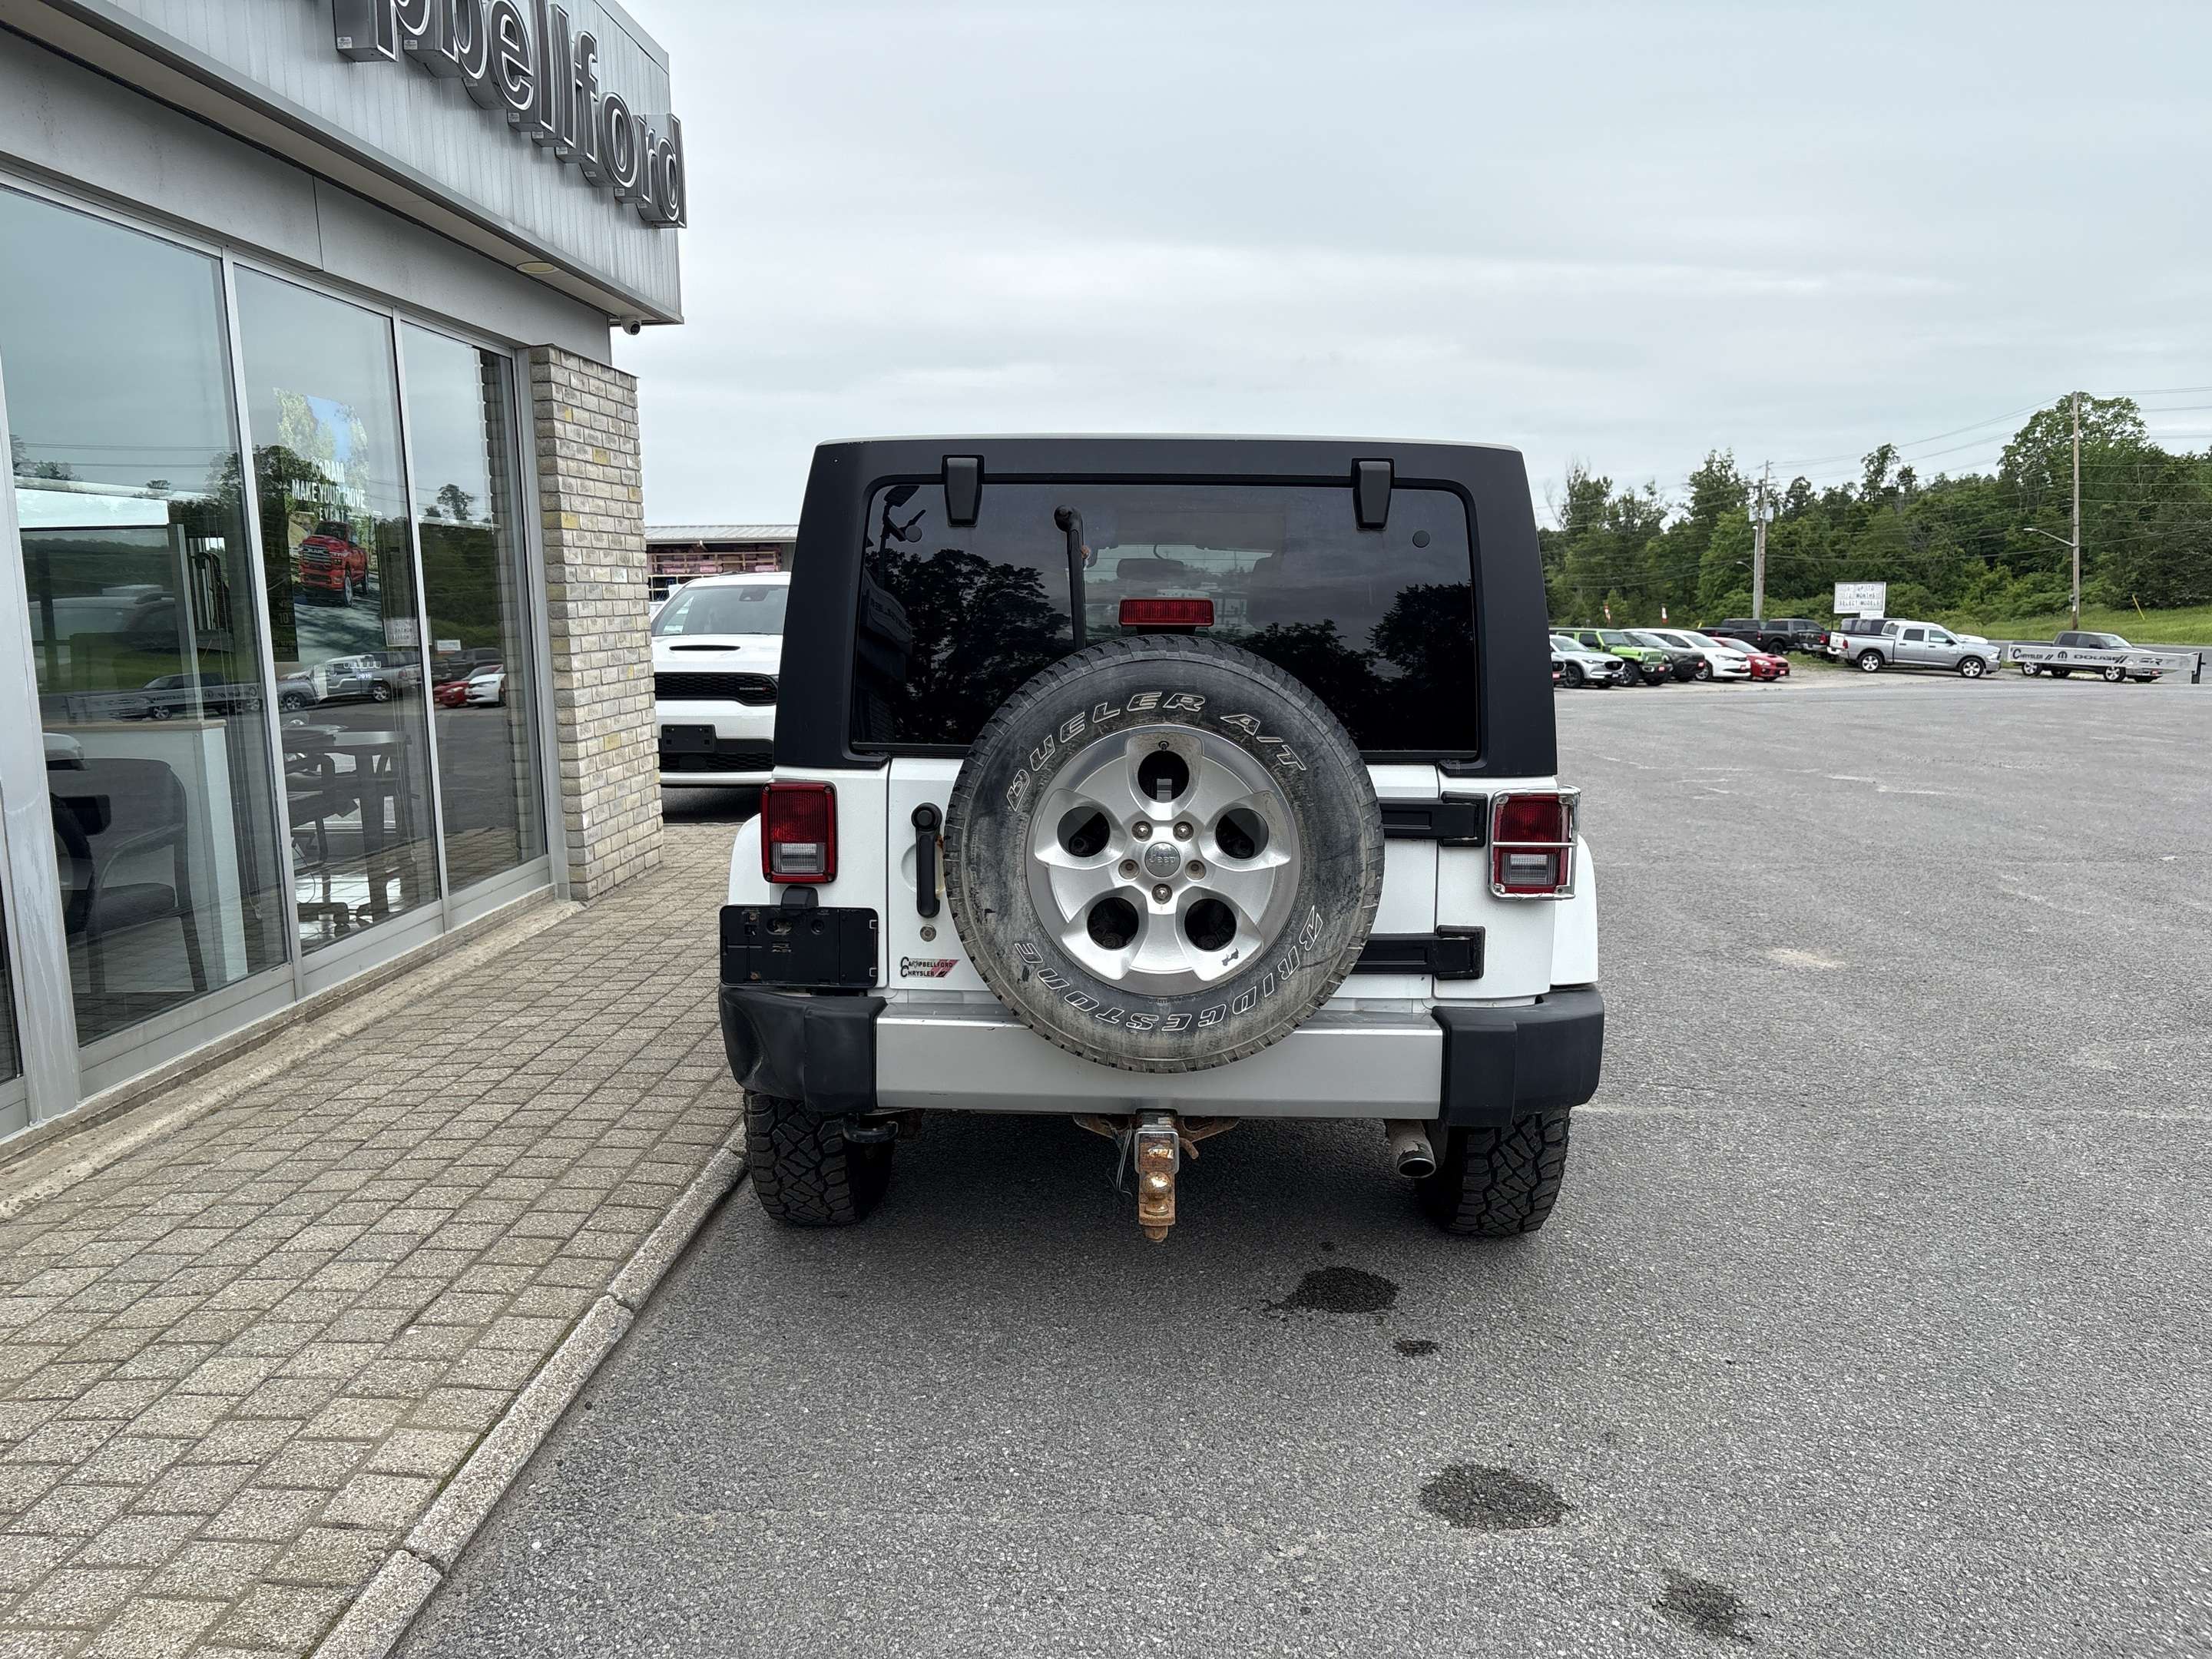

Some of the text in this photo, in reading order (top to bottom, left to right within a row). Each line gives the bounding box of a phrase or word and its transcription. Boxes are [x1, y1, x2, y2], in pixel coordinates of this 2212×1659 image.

[324, 459, 345, 483] RAM
[292, 478, 366, 508] MAKE YOUR MOVE
[319, 507, 346, 525] EVENT
[2012, 648, 2043, 660] CHRYSLER
[1006, 691, 1207, 812] DUELER
[1148, 854, 1175, 866] Jeep
[900, 965, 935, 978] CHRYSLER
[1014, 904, 1324, 1032] BRIDGESTONE
